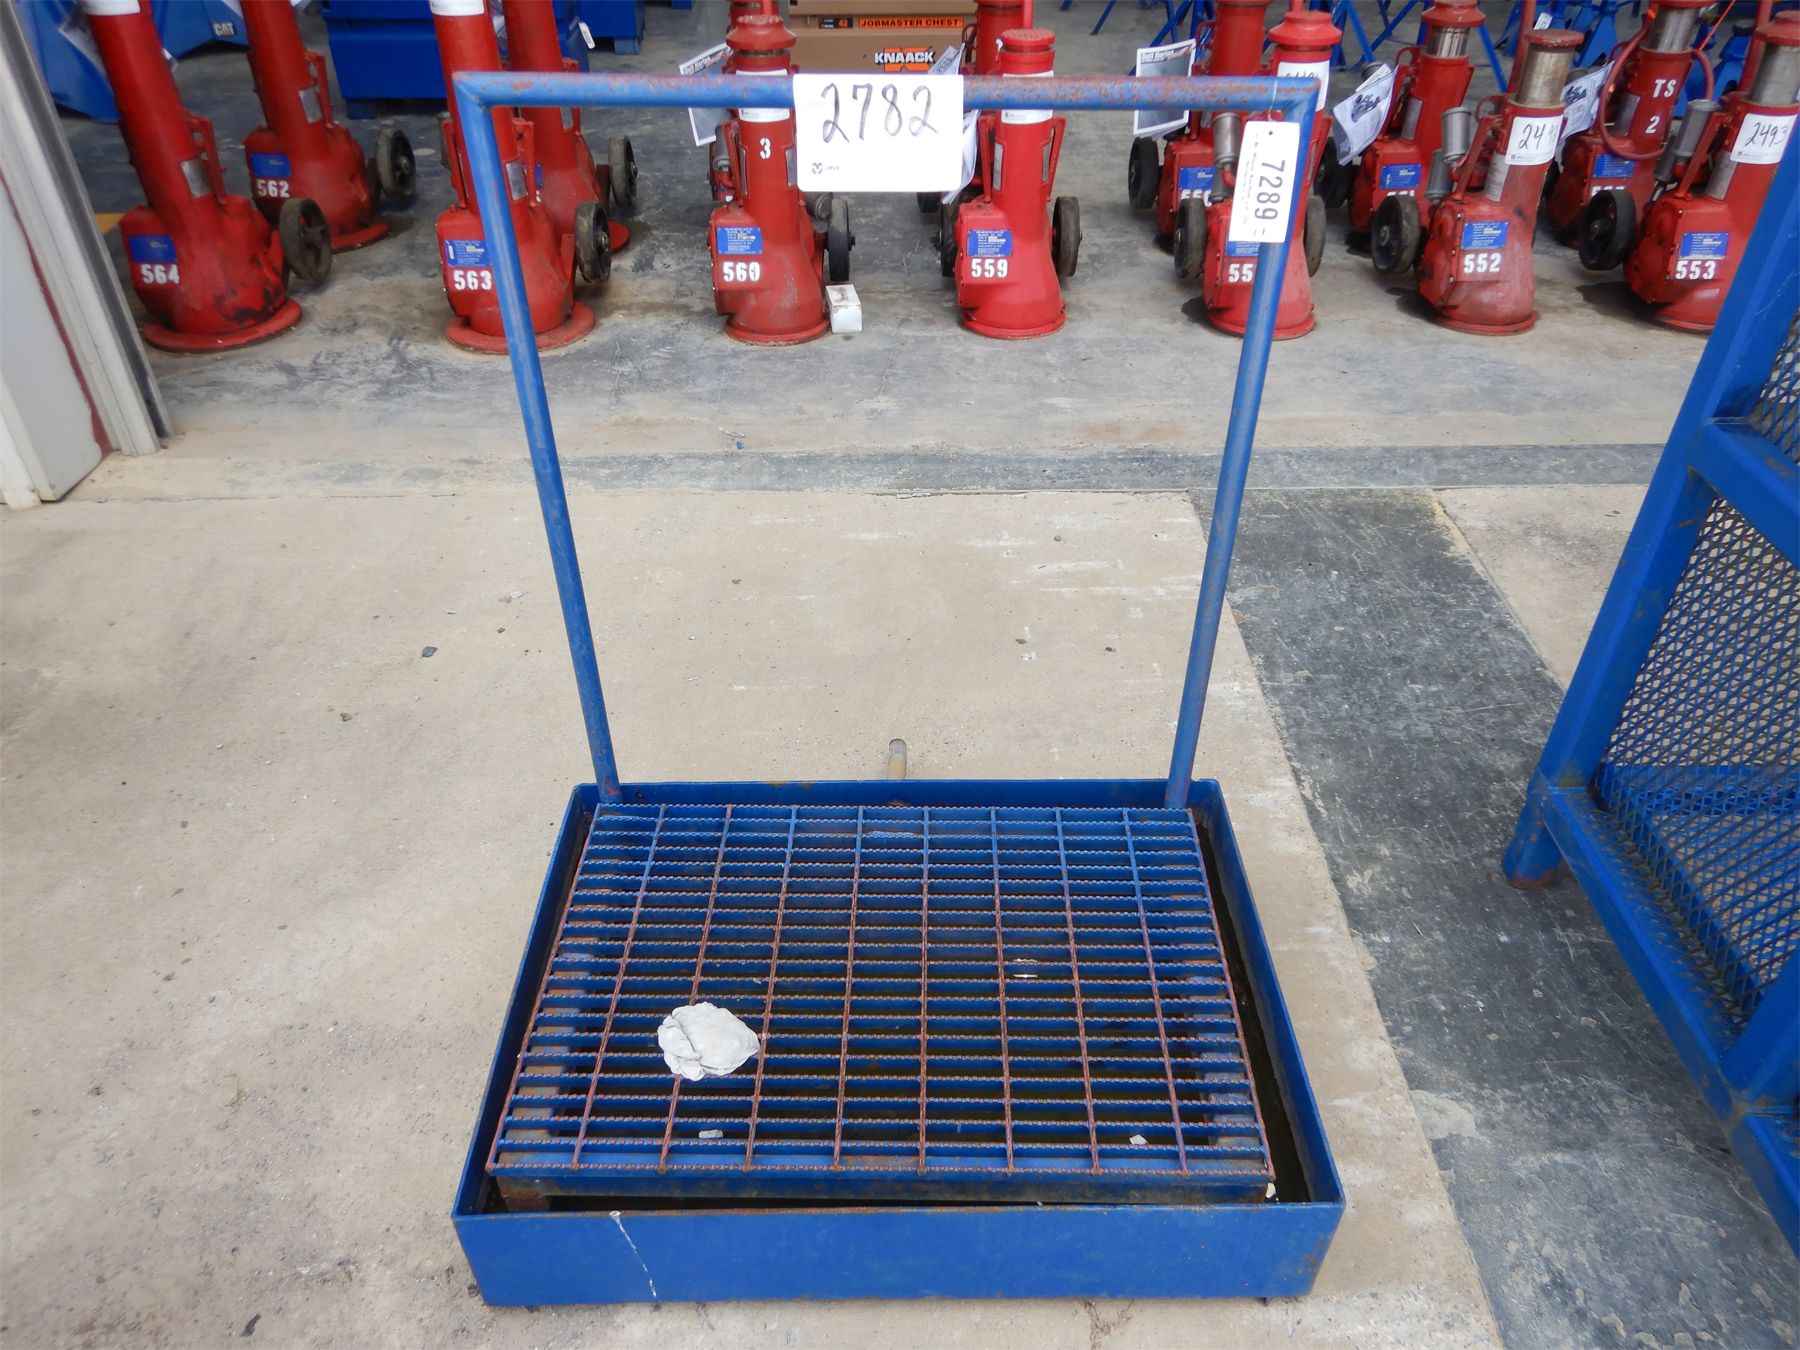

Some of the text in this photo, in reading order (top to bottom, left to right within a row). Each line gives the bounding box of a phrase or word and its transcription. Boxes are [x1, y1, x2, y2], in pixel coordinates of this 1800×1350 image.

[213, 22, 235, 36] CAT
[838, 18, 849, 28] 42
[861, 18, 959, 27] JOBMASTER CHEST
[874, 51, 934, 64] KNAACK
[1652, 79, 1677, 98] TS
[820, 82, 940, 144] 2782
[1644, 115, 1660, 134] 2
[1744, 122, 1790, 149] 2493
[759, 137, 771, 160] 3
[256, 178, 291, 198] 562
[1254, 160, 1286, 220] 7289
[971, 258, 1008, 278] 559
[1228, 263, 1254, 283] 55
[1463, 253, 1502, 274] 552
[1675, 260, 1717, 280] 553
[141, 264, 180, 284] 564
[453, 270, 492, 291] 563
